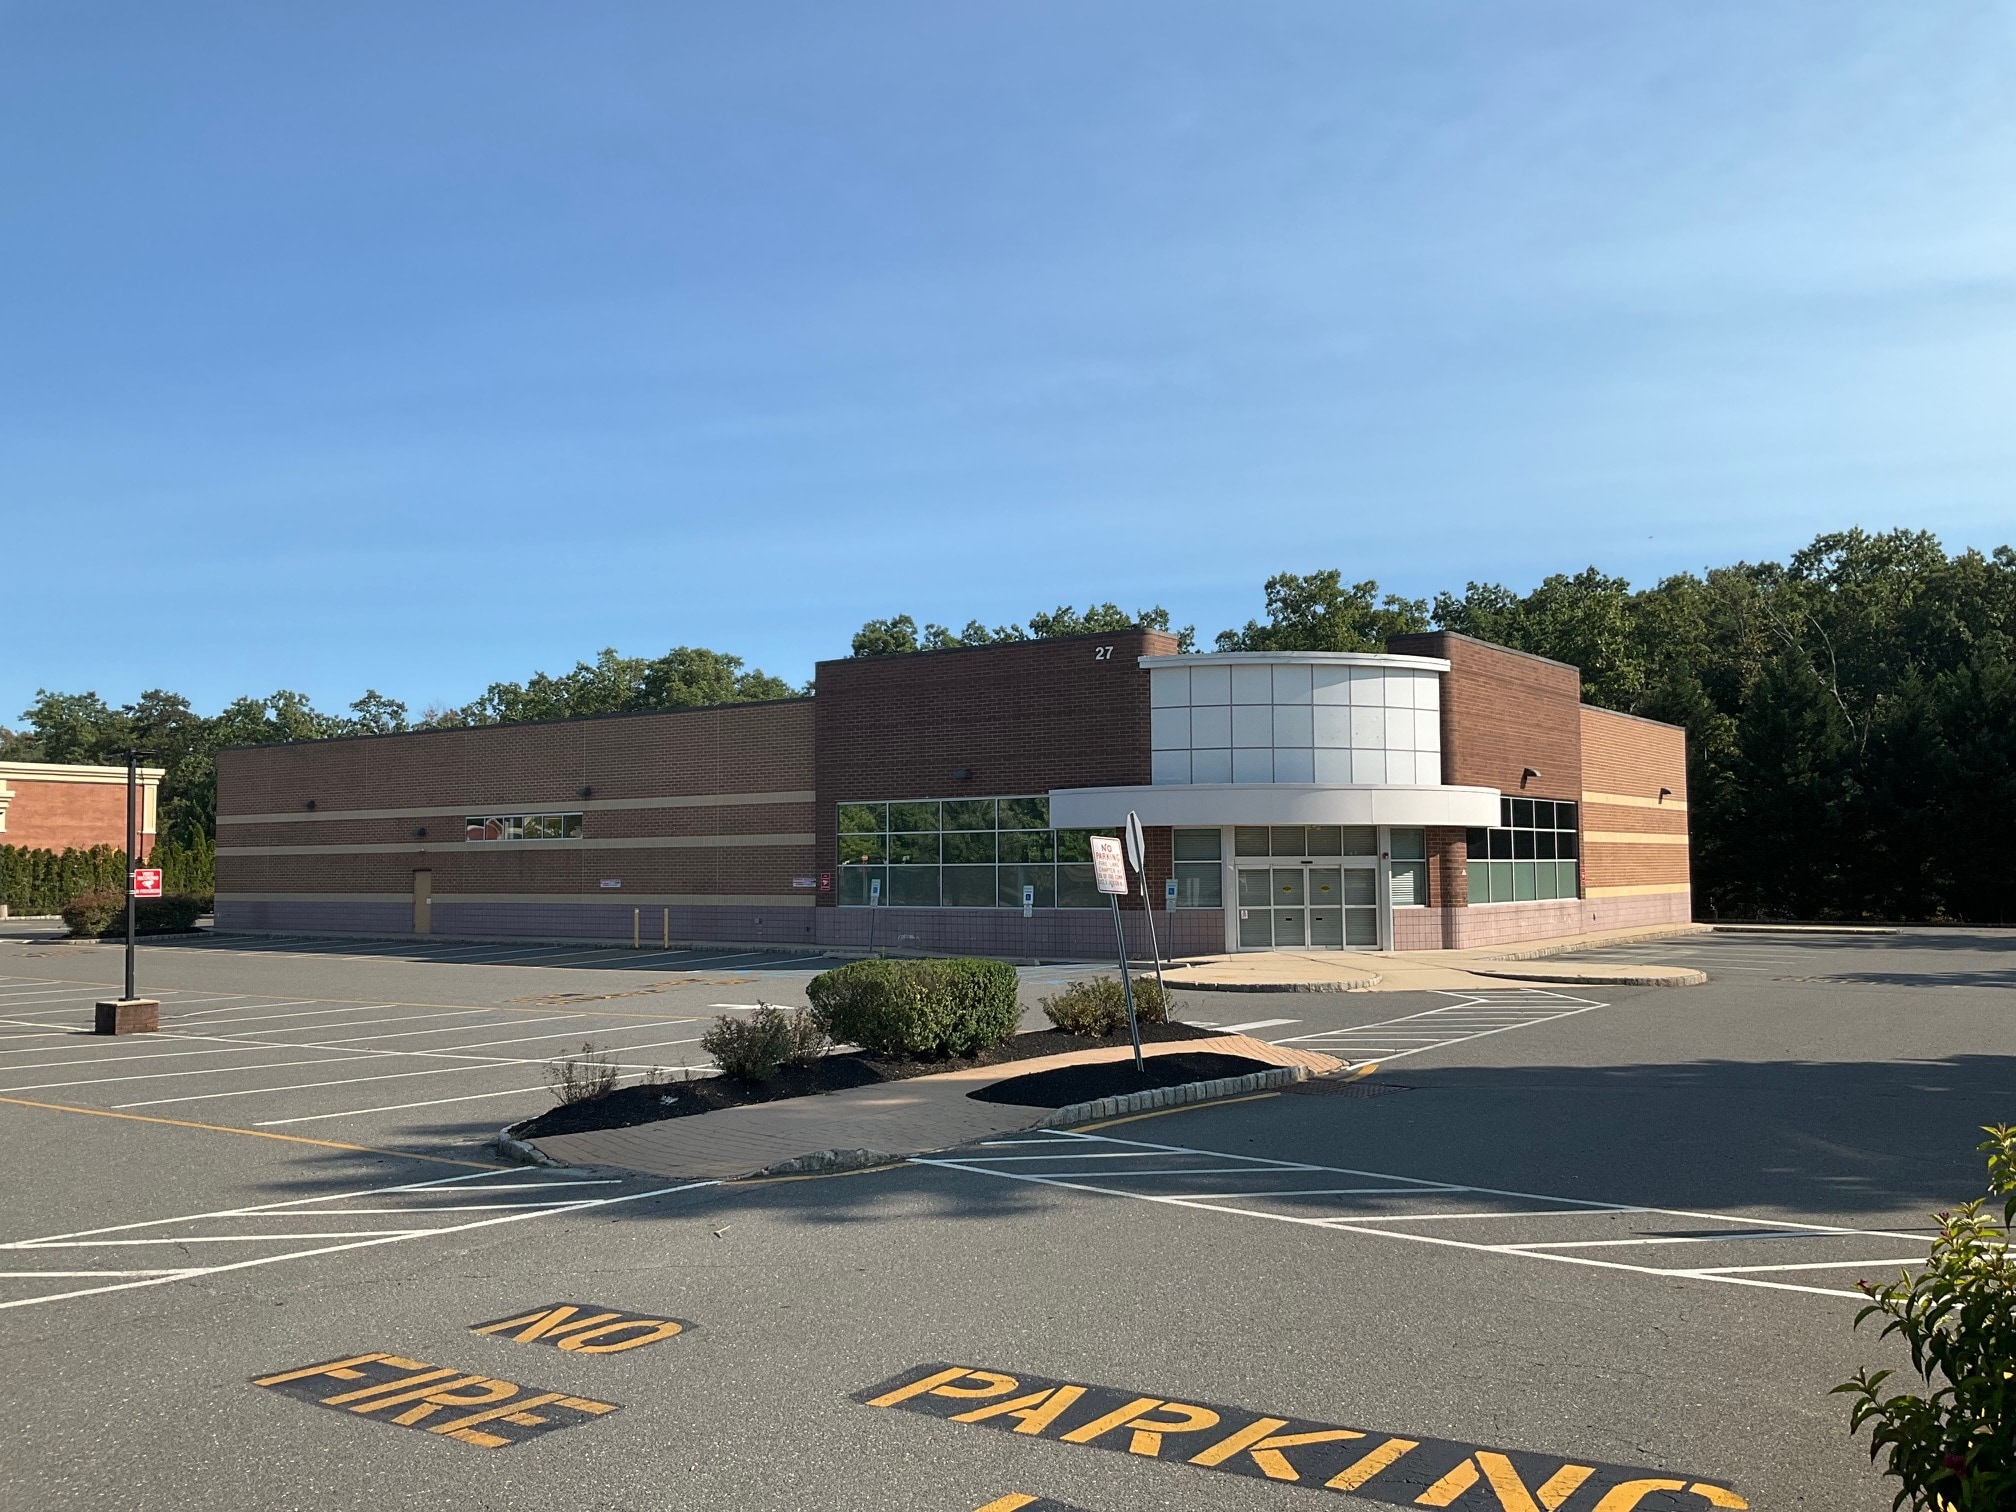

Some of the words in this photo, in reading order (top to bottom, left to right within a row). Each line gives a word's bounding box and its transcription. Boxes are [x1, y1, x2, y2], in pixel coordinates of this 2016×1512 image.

[1095, 646, 1114, 660] 27
[1101, 844, 1112, 852] NO
[1095, 852, 1120, 862] PARKING
[469, 1306, 683, 1353] NO
[253, 1352, 619, 1448] FIRE
